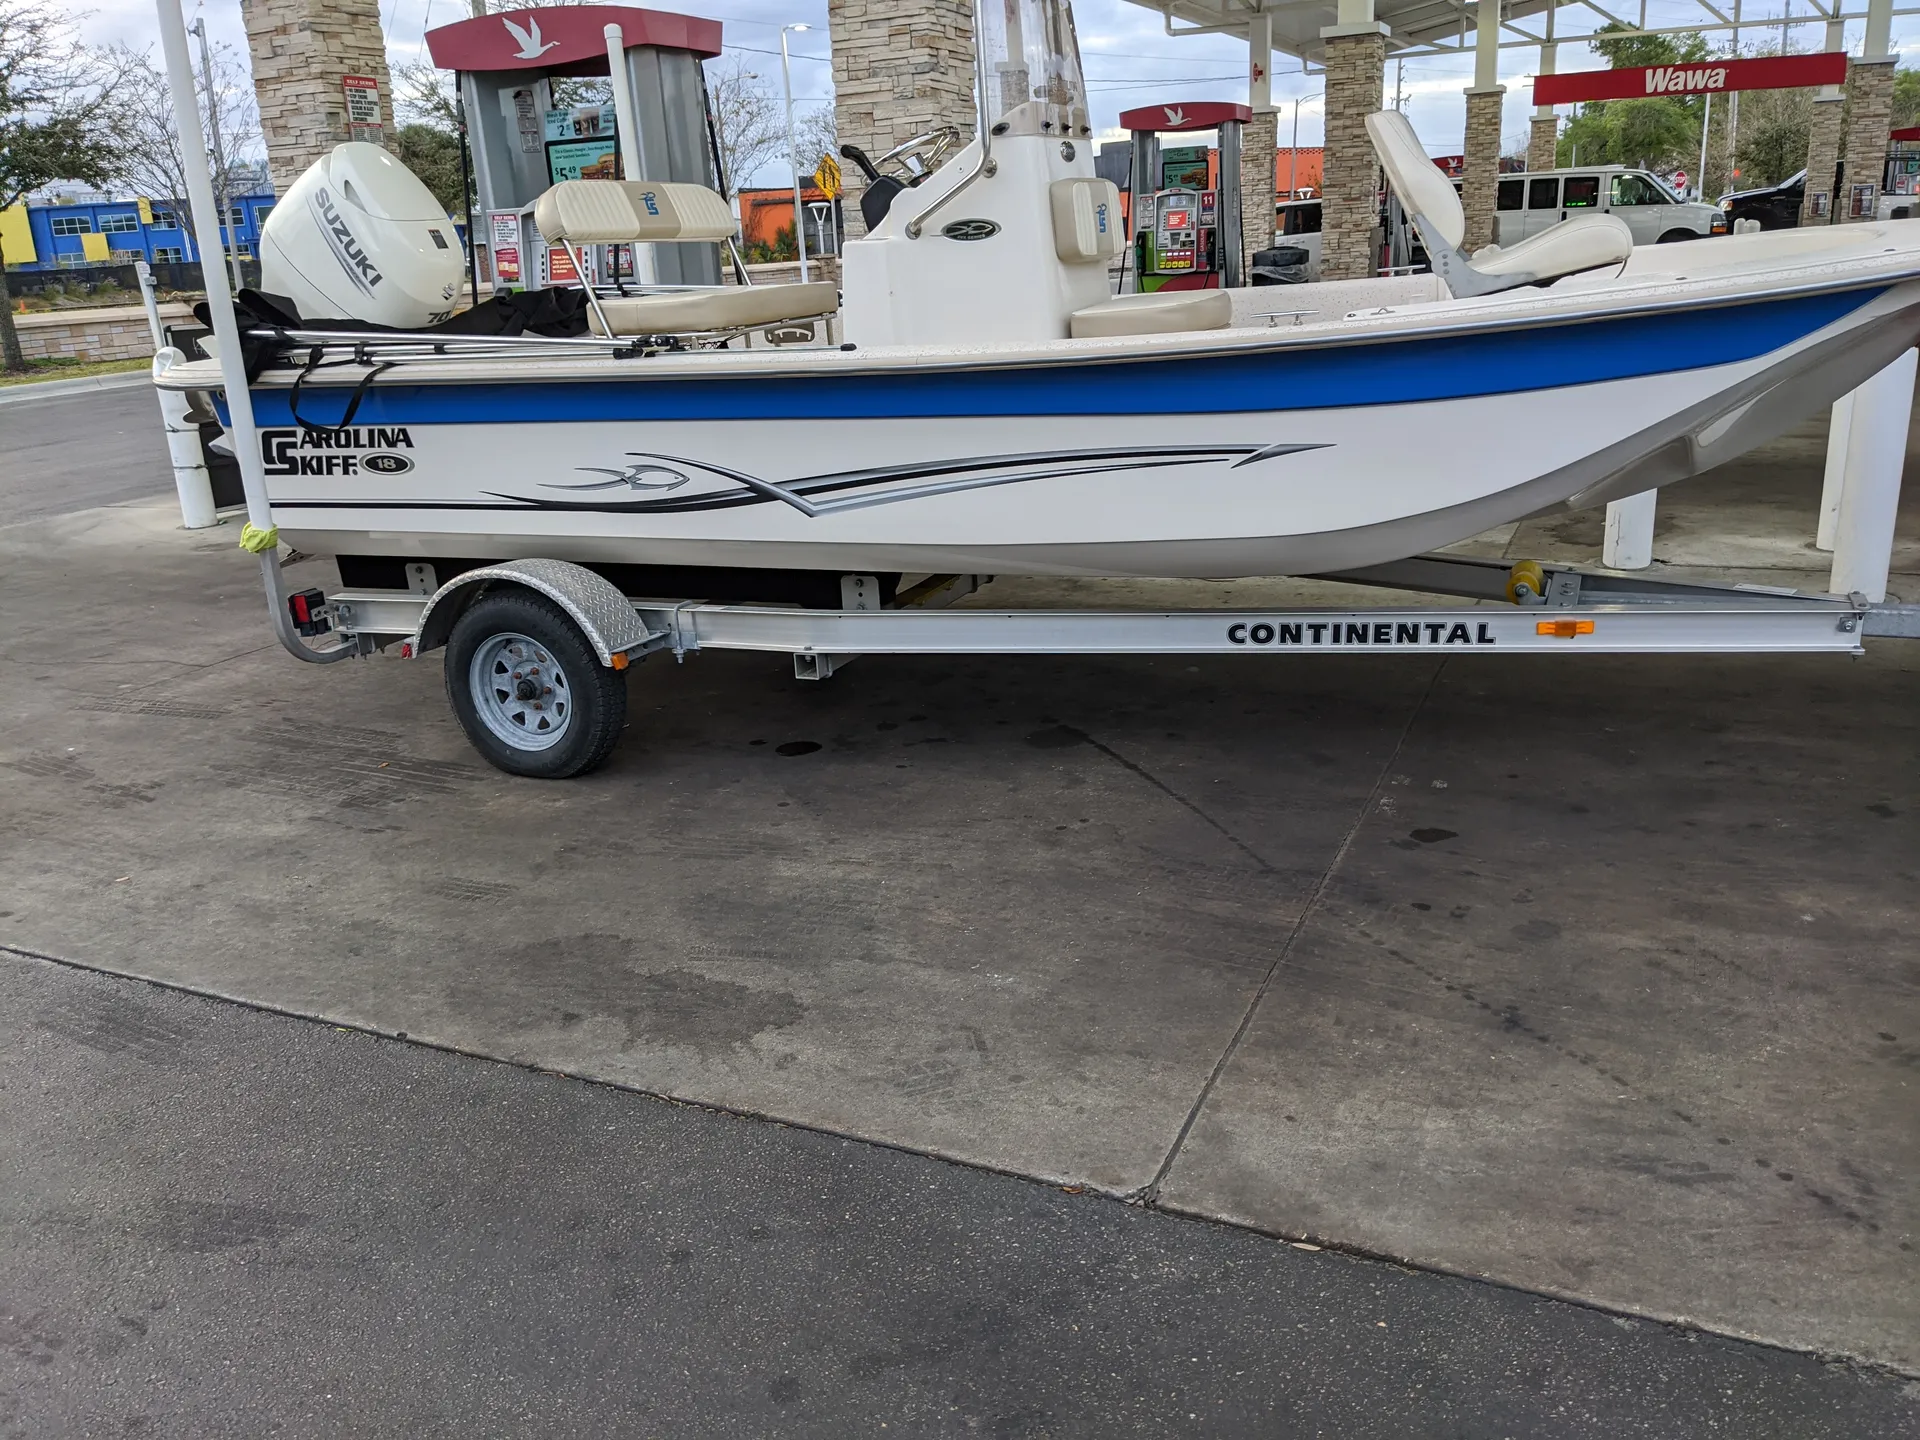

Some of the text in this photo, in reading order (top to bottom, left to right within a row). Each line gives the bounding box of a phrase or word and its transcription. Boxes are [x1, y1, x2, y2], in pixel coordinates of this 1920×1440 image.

[1645, 67, 1727, 94] Wawa
[1204, 196, 1212, 204] 11
[315, 187, 383, 288] SUZUKI
[426, 310, 451, 324] 70
[376, 458, 397, 470] 18
[1226, 622, 1496, 645] CONTINENTAL
